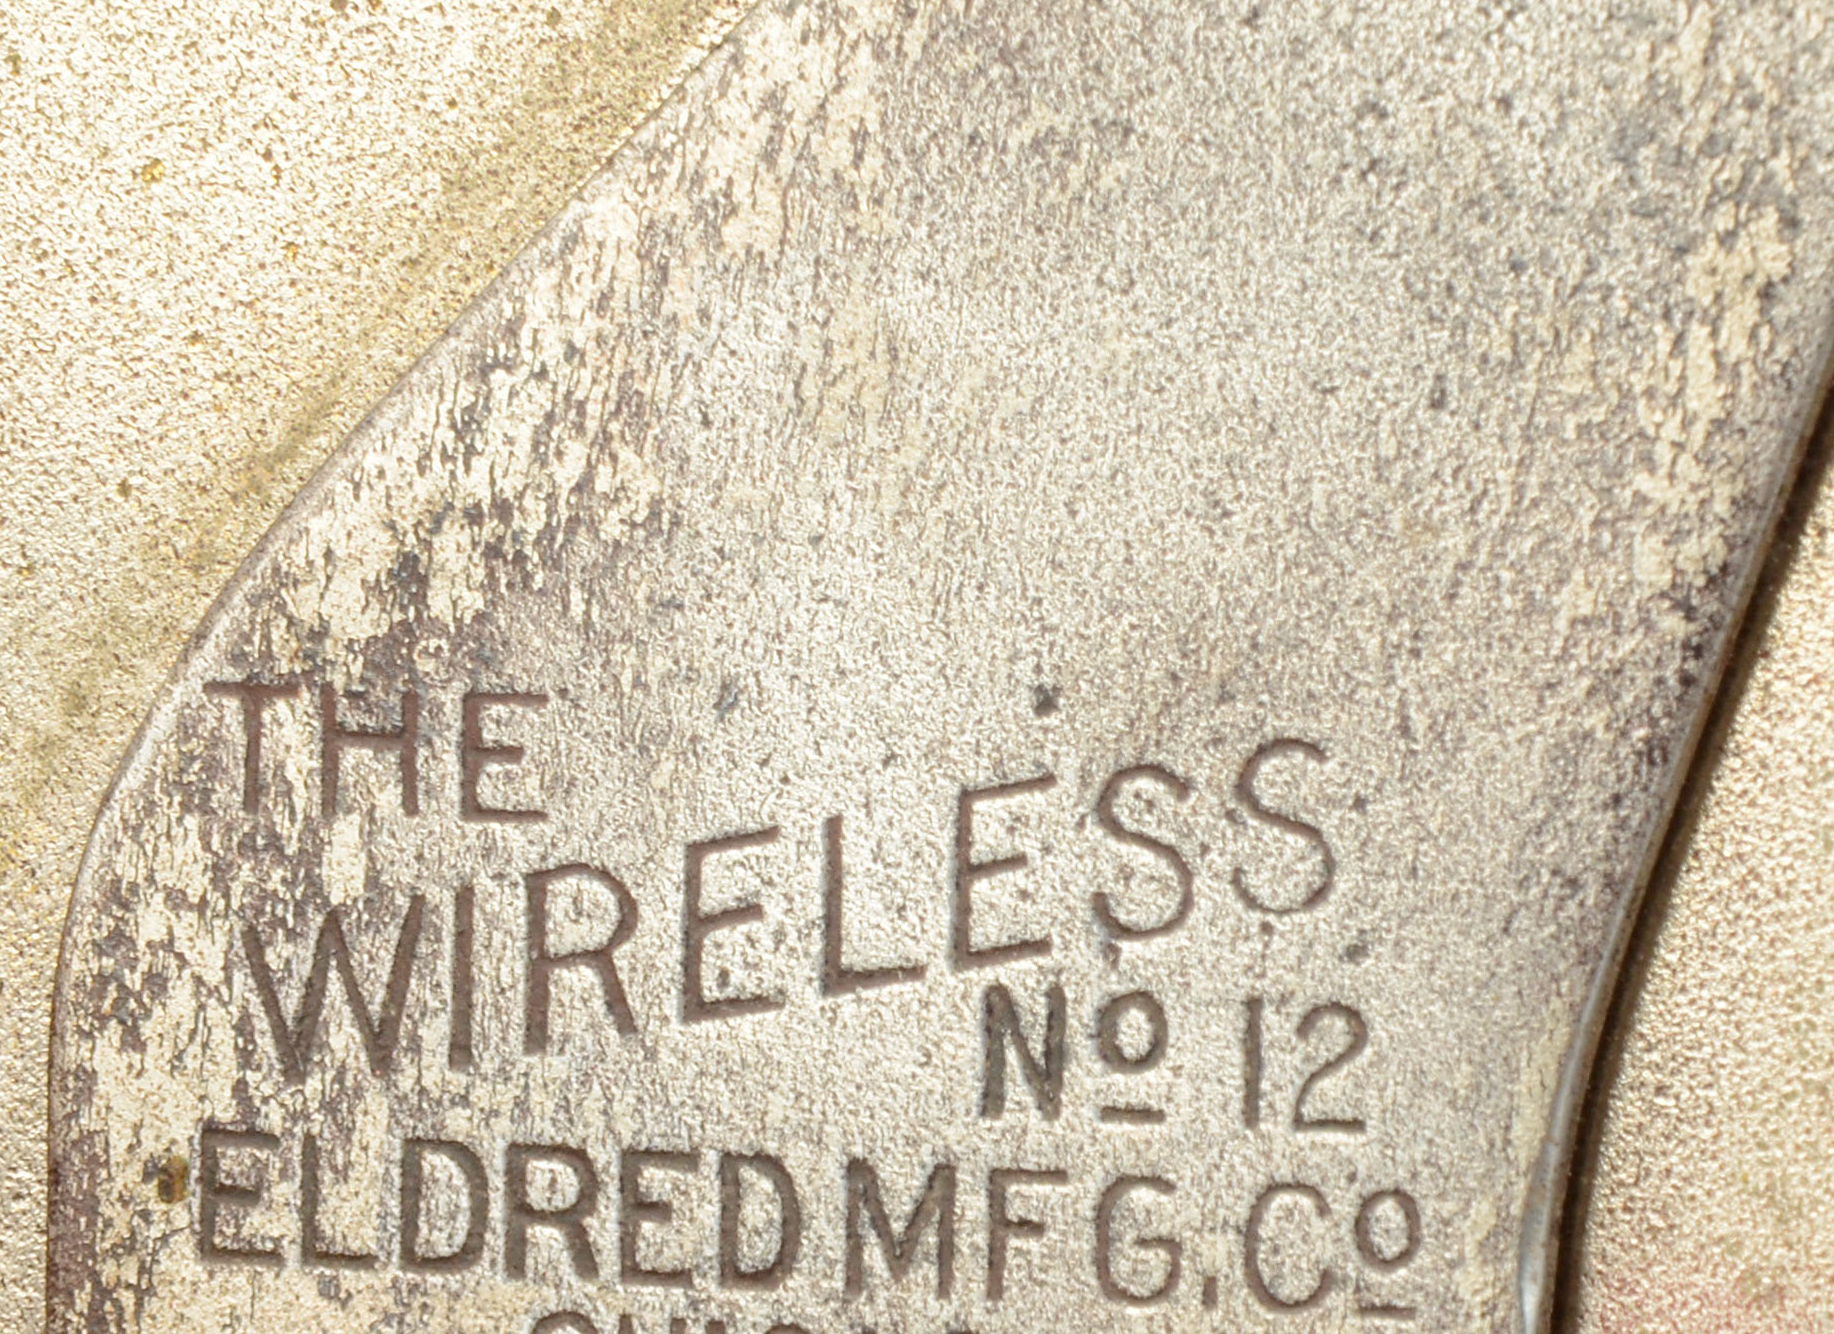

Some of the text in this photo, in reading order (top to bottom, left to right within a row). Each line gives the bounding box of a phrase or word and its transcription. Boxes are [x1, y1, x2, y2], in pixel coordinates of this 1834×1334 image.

[202, 678, 550, 822] THE
[240, 736, 1337, 1083] WIRELESS
[1242, 996, 1367, 1133] 12
[199, 1125, 803, 1290] ELDRED
